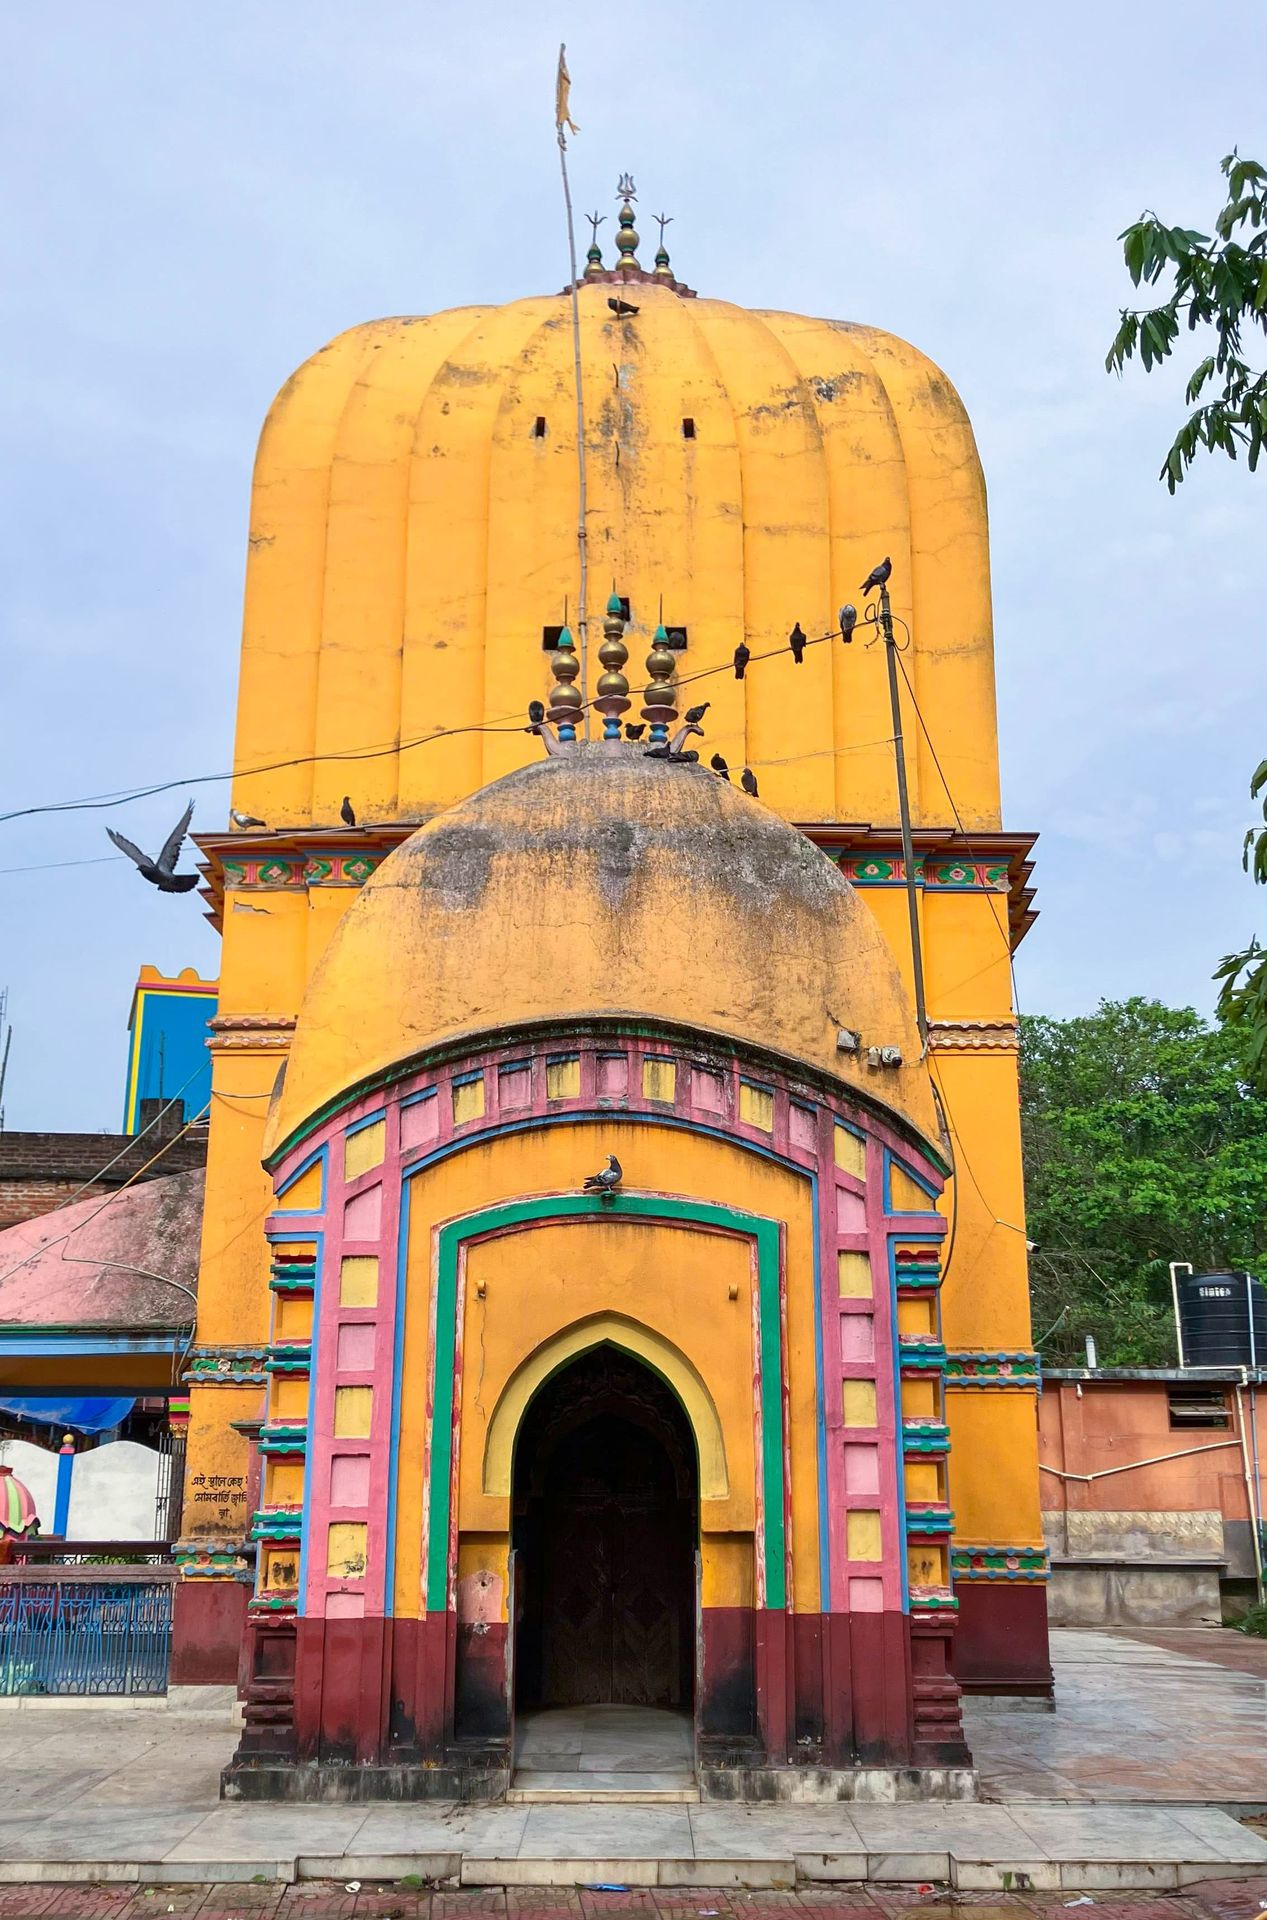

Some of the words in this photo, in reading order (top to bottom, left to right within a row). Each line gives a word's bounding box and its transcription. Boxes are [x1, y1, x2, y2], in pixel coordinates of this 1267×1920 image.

[191, 1473, 208, 1489] এই
[208, 1475, 227, 1490] স্থানে
[227, 1477, 243, 1491] কেহ
